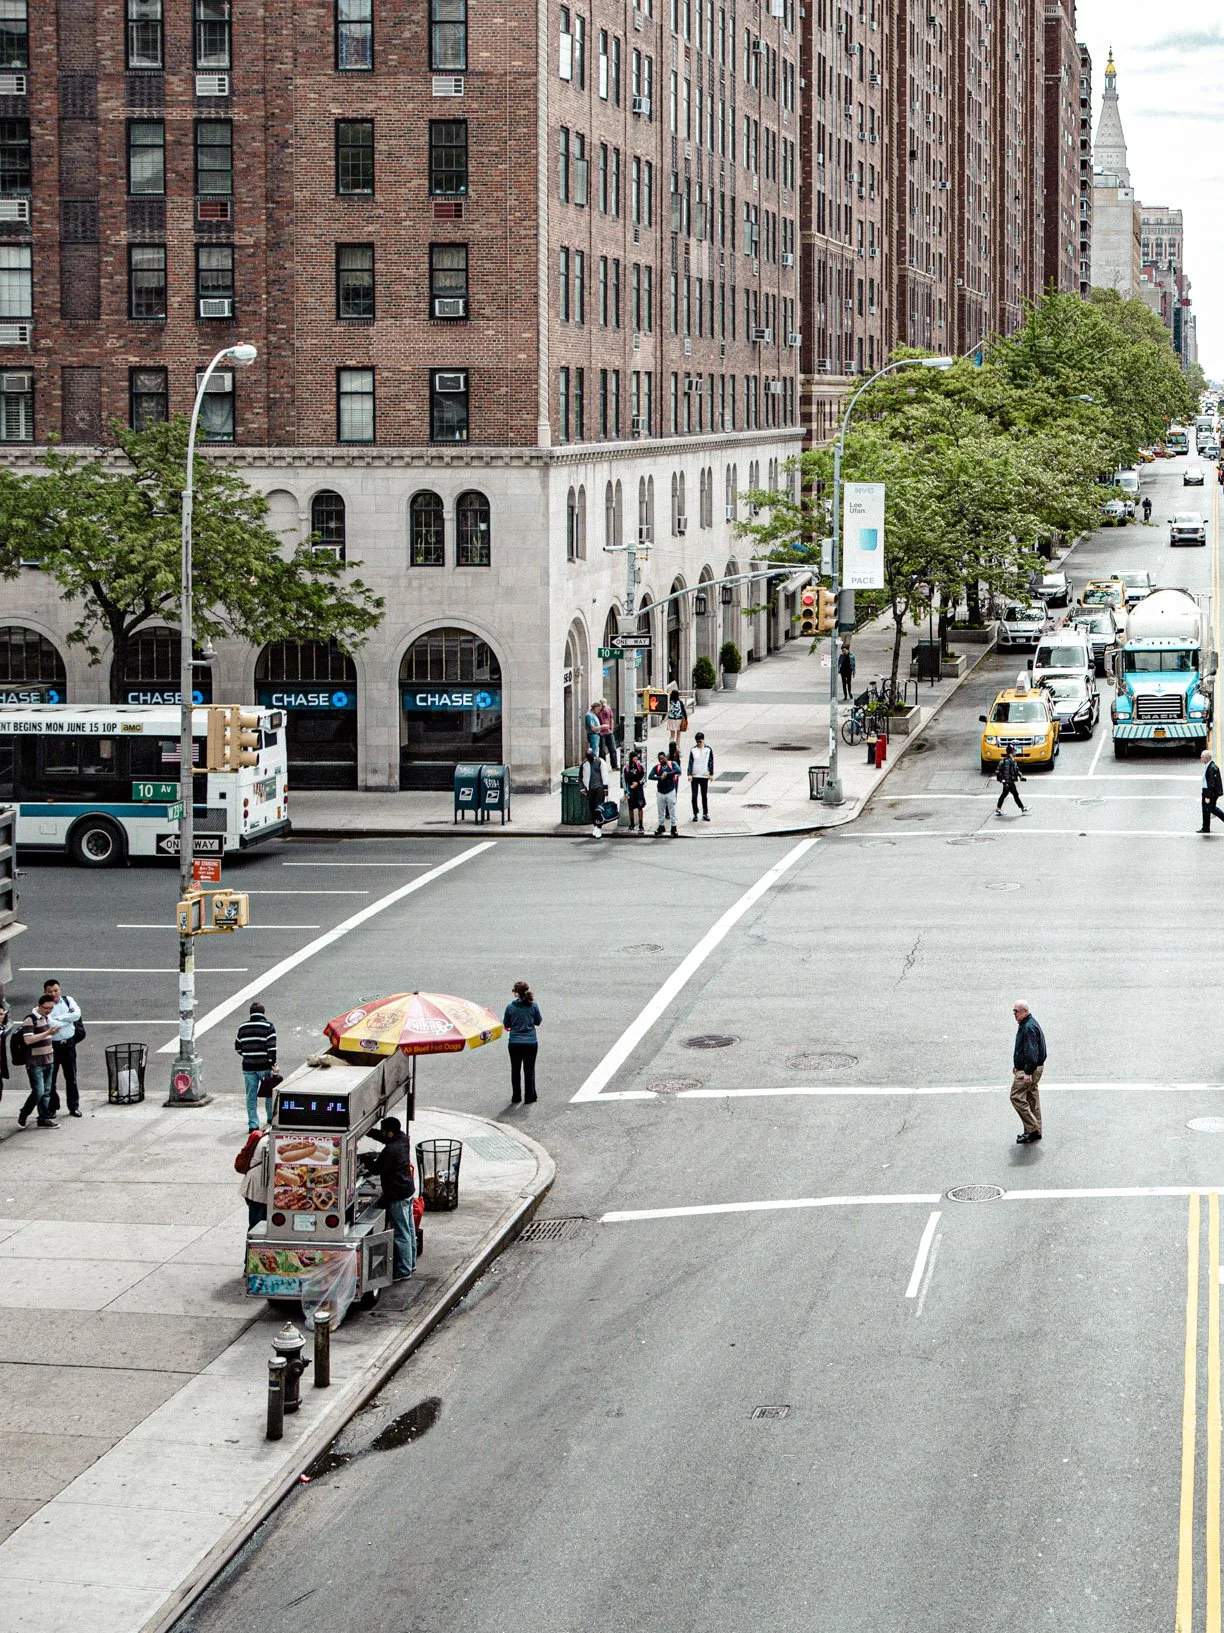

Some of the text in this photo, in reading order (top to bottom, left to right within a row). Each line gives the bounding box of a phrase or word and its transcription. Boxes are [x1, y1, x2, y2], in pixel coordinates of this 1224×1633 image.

[601, 649, 610, 657] 10
[0, 693, 40, 704] ASE
[128, 692, 182, 704] CHASE
[272, 693, 330, 706] CHASE
[416, 693, 473, 706] CHASE
[0, 722, 11, 731] NT
[14, 722, 42, 731] BEGINS
[45, 722, 63, 732] MON
[66, 722, 86, 732] JUNE
[89, 723, 98, 732] 15
[102, 723, 117, 732] 10P
[138, 784, 172, 797] 10 Av
